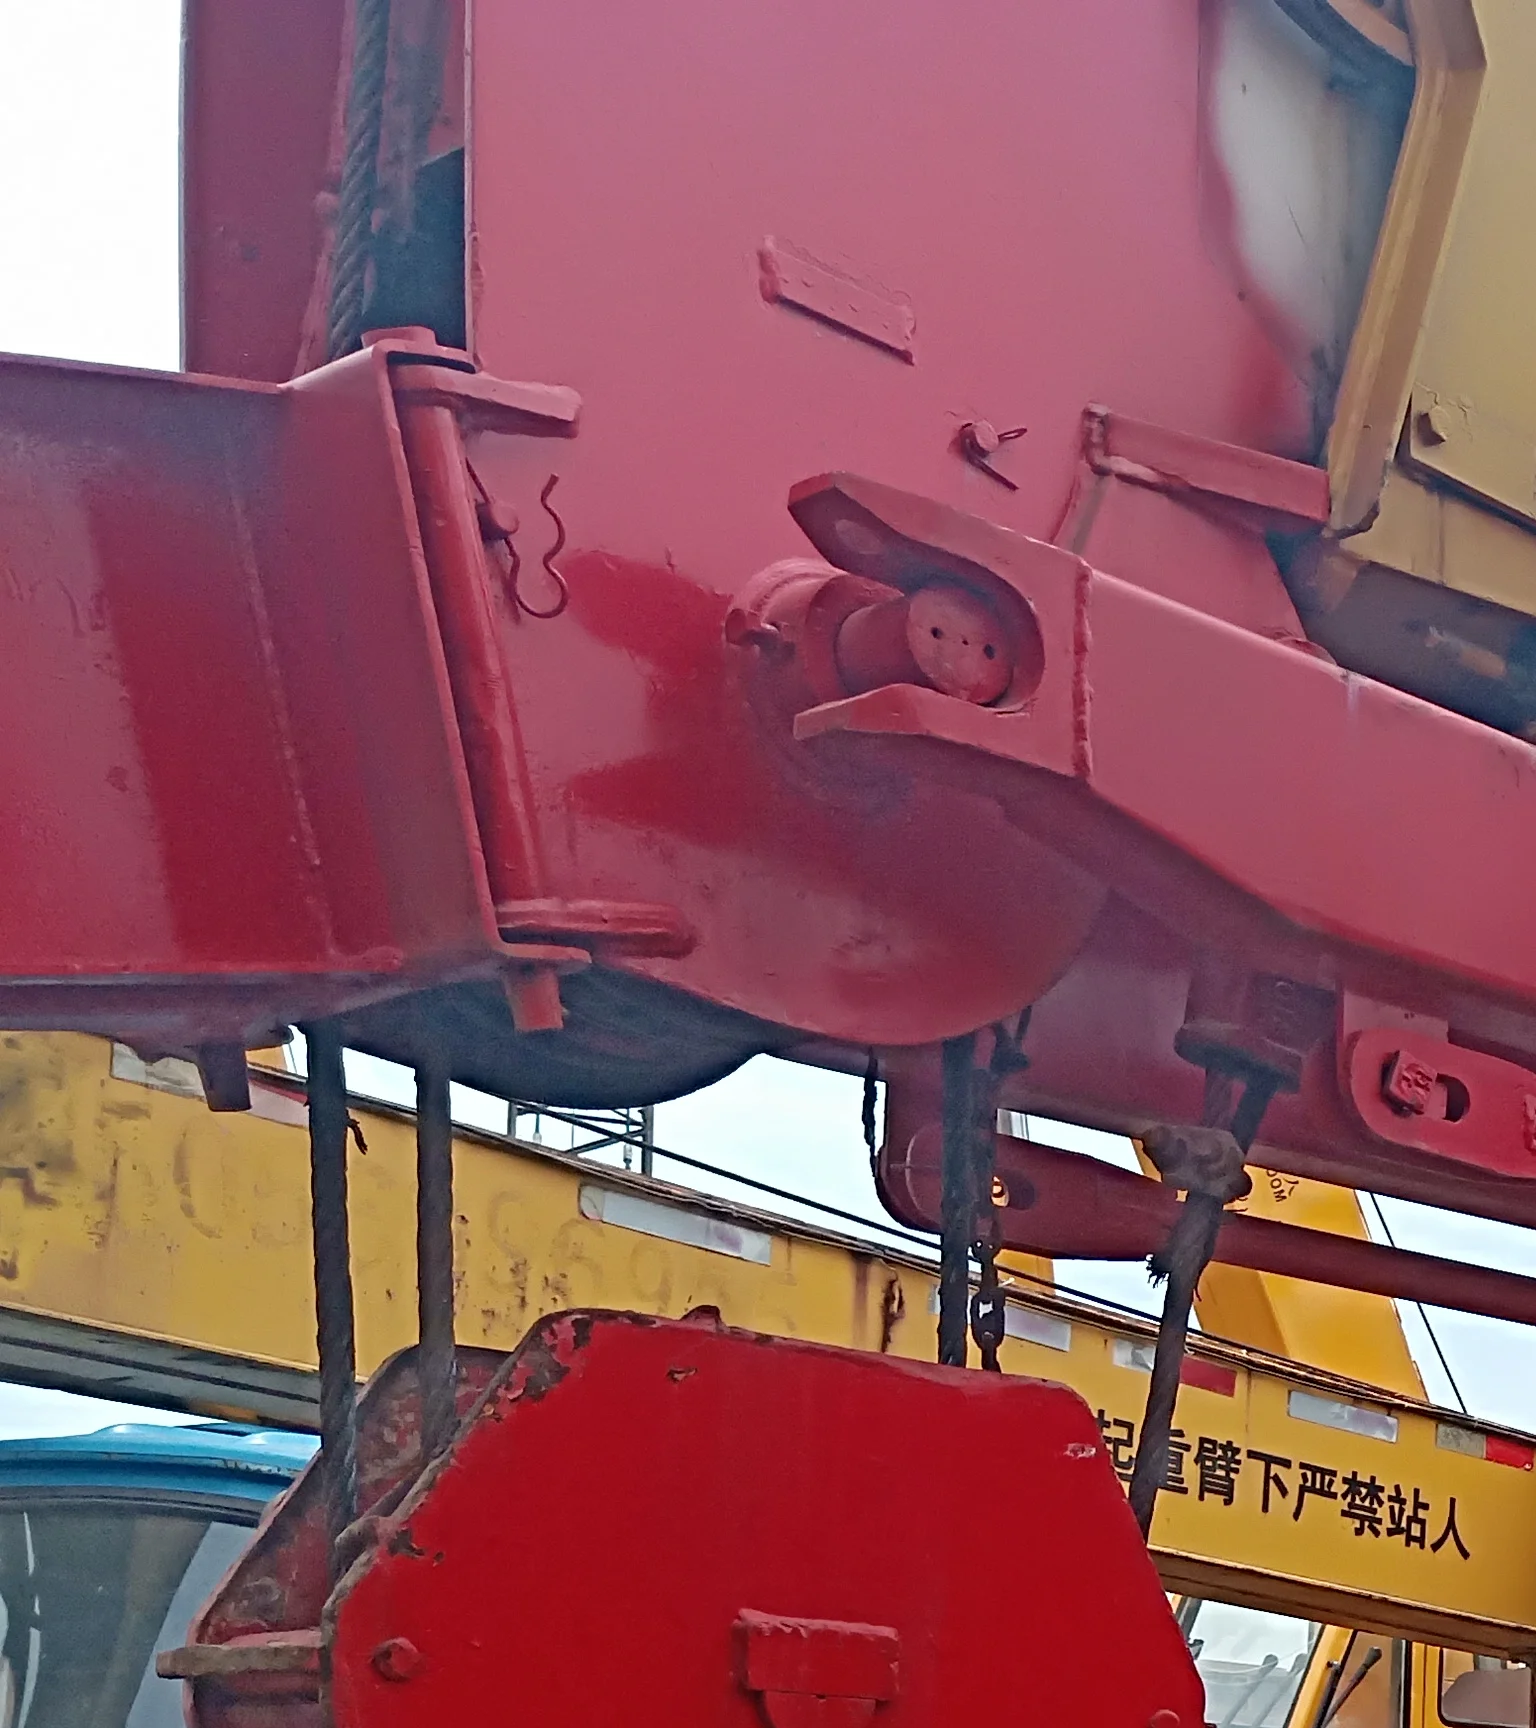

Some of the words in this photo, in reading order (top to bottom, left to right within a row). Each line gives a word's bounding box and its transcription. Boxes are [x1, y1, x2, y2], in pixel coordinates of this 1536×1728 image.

[1097, 1408, 1471, 1561] 起重臂下严禁站人
